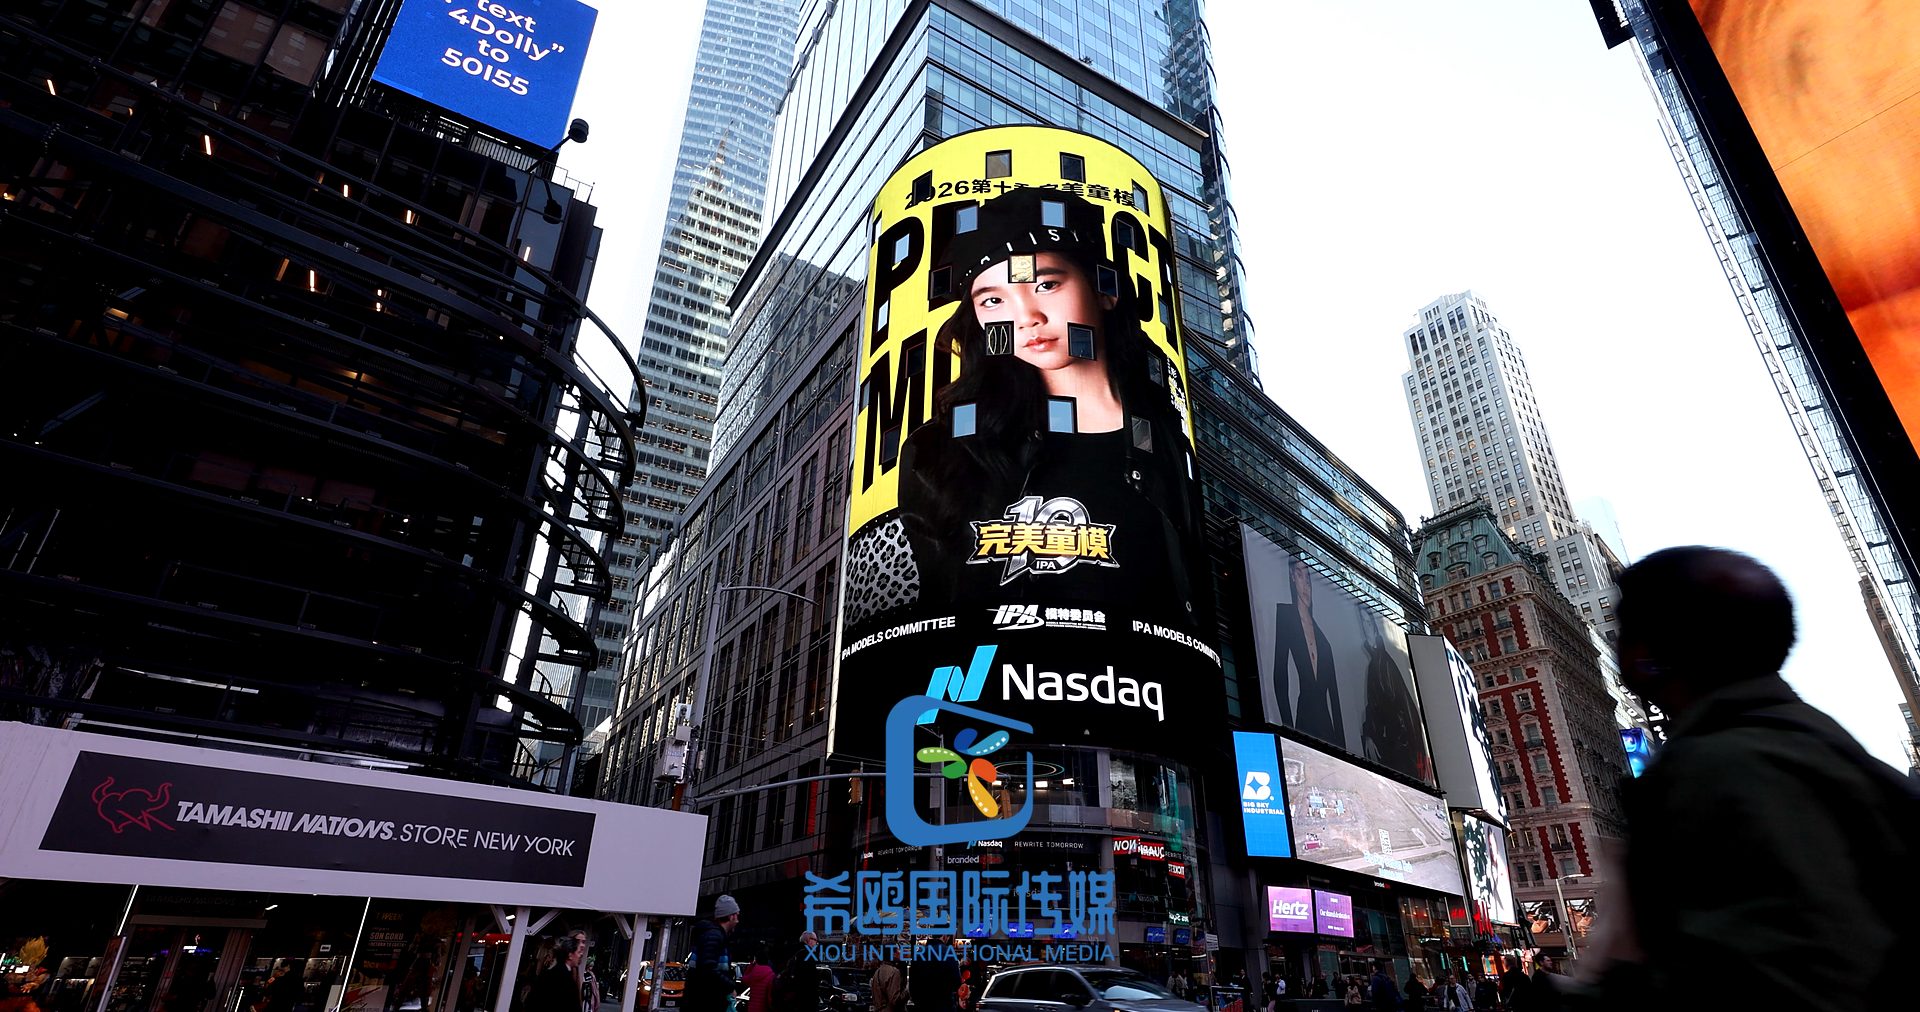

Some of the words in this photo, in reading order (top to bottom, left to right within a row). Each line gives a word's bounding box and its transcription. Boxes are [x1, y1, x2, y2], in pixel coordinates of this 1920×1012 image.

[477, 0, 537, 33] text
[478, 38, 510, 63] to
[441, 48, 530, 96] 50155
[977, 523, 1110, 559] 完美童模
[1036, 560, 1056, 570] IPA
[993, 604, 1040, 625] IPA
[851, 632, 884, 654] MODELS
[885, 616, 956, 640] COMMITTEE
[1132, 620, 1152, 634] IPA
[1153, 625, 1193, 647] MODELS
[1002, 663, 1165, 722] Nasdaq
[1243, 808, 1285, 816] INDUSTRIAL
[176, 801, 293, 831] TAMASHII
[400, 823, 468, 848] STORE
[474, 830, 520, 852] NEW
[524, 835, 577, 857] YORK
[978, 839, 1003, 849] Nasdaq
[1046, 841, 1084, 849] TOMORROW
[947, 855, 980, 864] branded
[1273, 899, 1310, 916] Hertz
